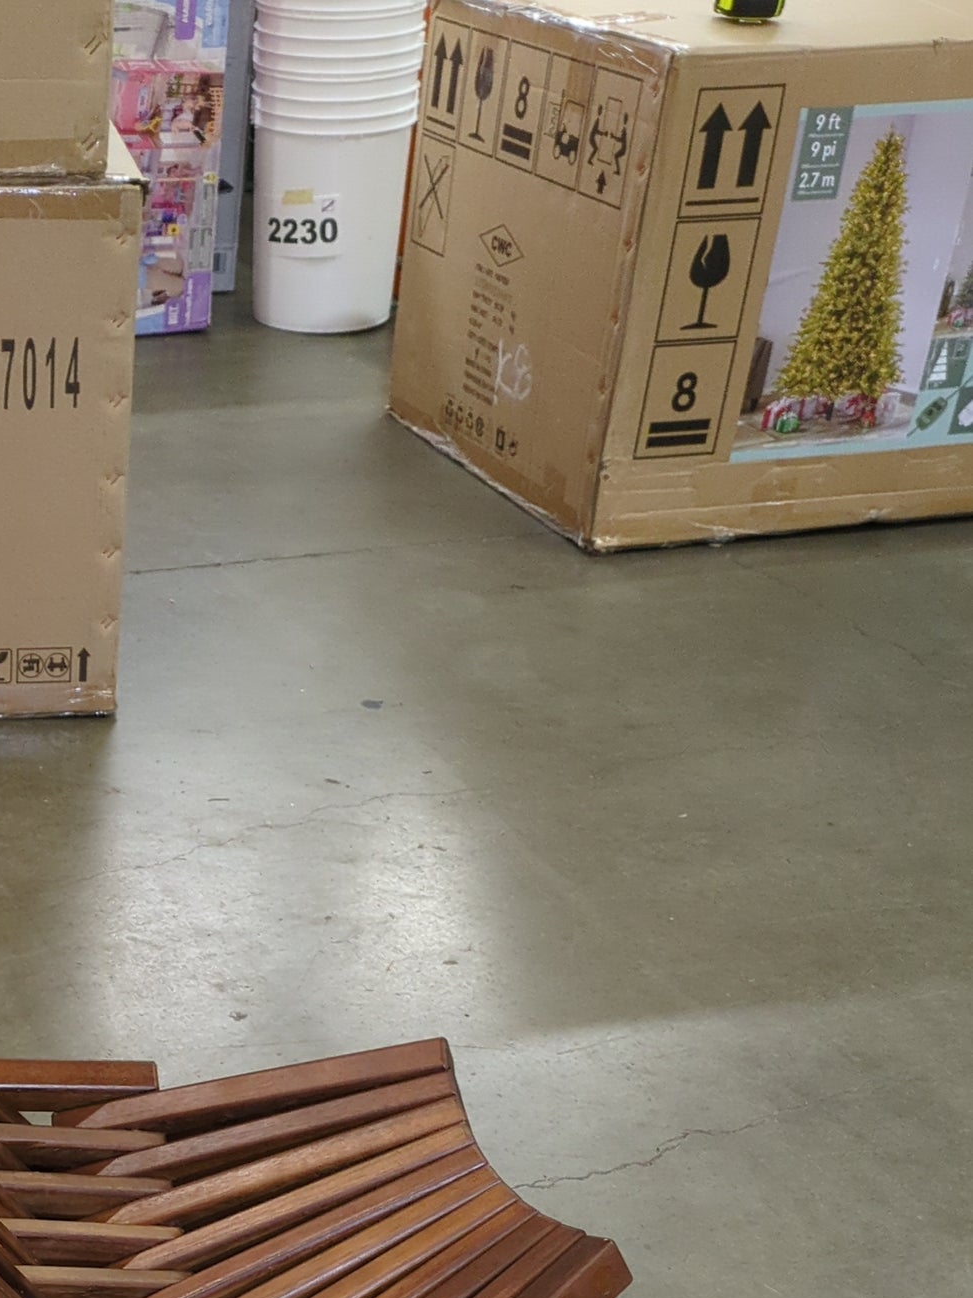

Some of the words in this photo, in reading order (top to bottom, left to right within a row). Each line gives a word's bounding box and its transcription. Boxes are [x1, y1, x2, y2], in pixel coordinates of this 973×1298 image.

[816, 114, 827, 132] 9
[828, 113, 842, 130] ft
[811, 141, 821, 158] 9
[822, 140, 838, 162] pi
[798, 172, 821, 188] 2.7
[821, 175, 836, 187] m
[267, 216, 338, 245] 2230
[671, 371, 698, 413] 8
